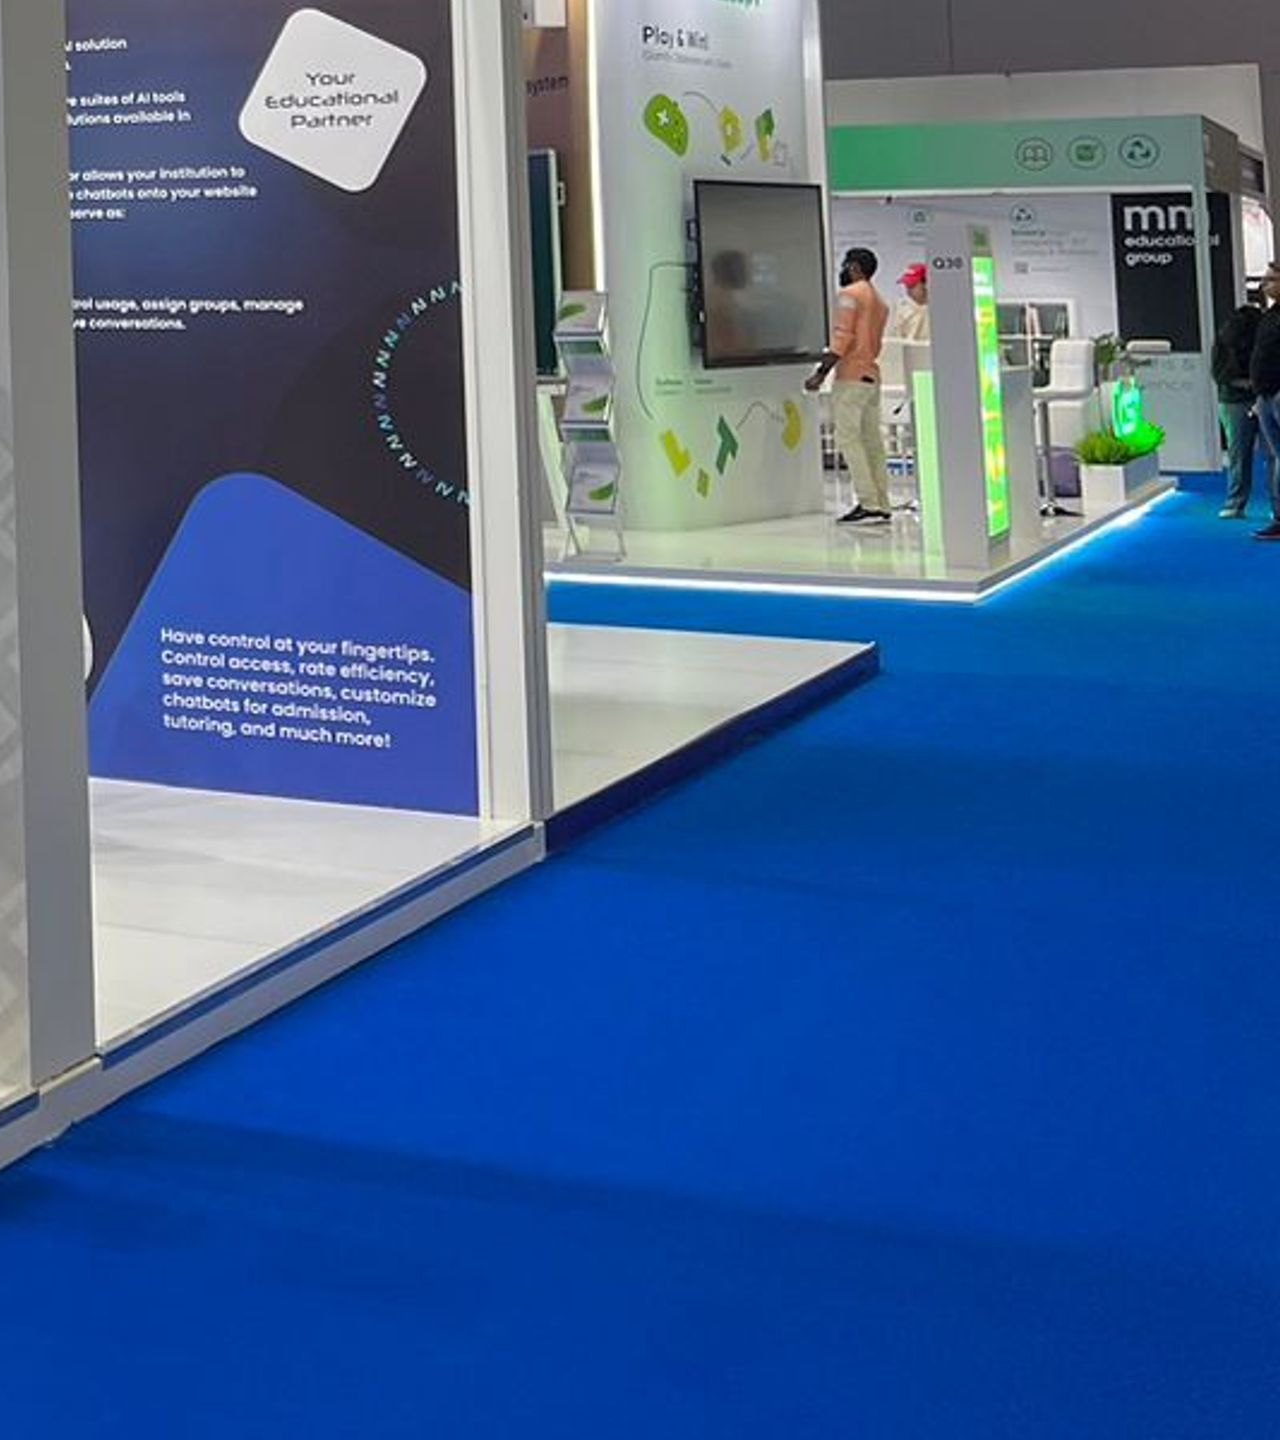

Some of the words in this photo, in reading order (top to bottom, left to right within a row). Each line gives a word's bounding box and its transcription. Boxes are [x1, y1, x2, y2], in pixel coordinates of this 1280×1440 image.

[75, 38, 127, 51] solution
[305, 72, 356, 86] Your
[80, 93, 119, 106] suites
[120, 91, 134, 104] of
[136, 91, 151, 104] AI
[152, 90, 186, 102] tools
[264, 89, 398, 109] Educational
[113, 110, 175, 124] available
[177, 108, 192, 121] in
[291, 114, 373, 130] Partner
[82, 169, 124, 181] allows
[126, 170, 156, 183] your
[159, 166, 228, 179] institution
[230, 166, 246, 178] to
[76, 187, 134, 200] chatbots
[137, 187, 168, 199] onto
[170, 188, 201, 202] your
[204, 185, 258, 198] website
[1125, 252, 1173, 267] group
[94, 299, 139, 313] usage,
[142, 298, 187, 313] assign
[243, 299, 304, 314] manage
[161, 628, 205, 645] Have
[208, 634, 271, 649] control
[273, 637, 293, 651] at
[297, 641, 337, 656] your
[341, 640, 434, 665] fingertips.
[161, 650, 225, 667] Control
[229, 658, 295, 675] access,
[299, 662, 336, 677] rate
[339, 664, 435, 688] efficiency,
[162, 672, 203, 687] save
[207, 677, 337, 701] conversations,
[341, 686, 437, 707] customize
[162, 692, 239, 712] chatbots
[243, 698, 267, 715] for
[272, 703, 371, 726] admission,
[163, 713, 237, 738] tutoring,
[240, 722, 275, 738] and
[279, 725, 332, 744] much
[335, 732, 391, 749] more!
